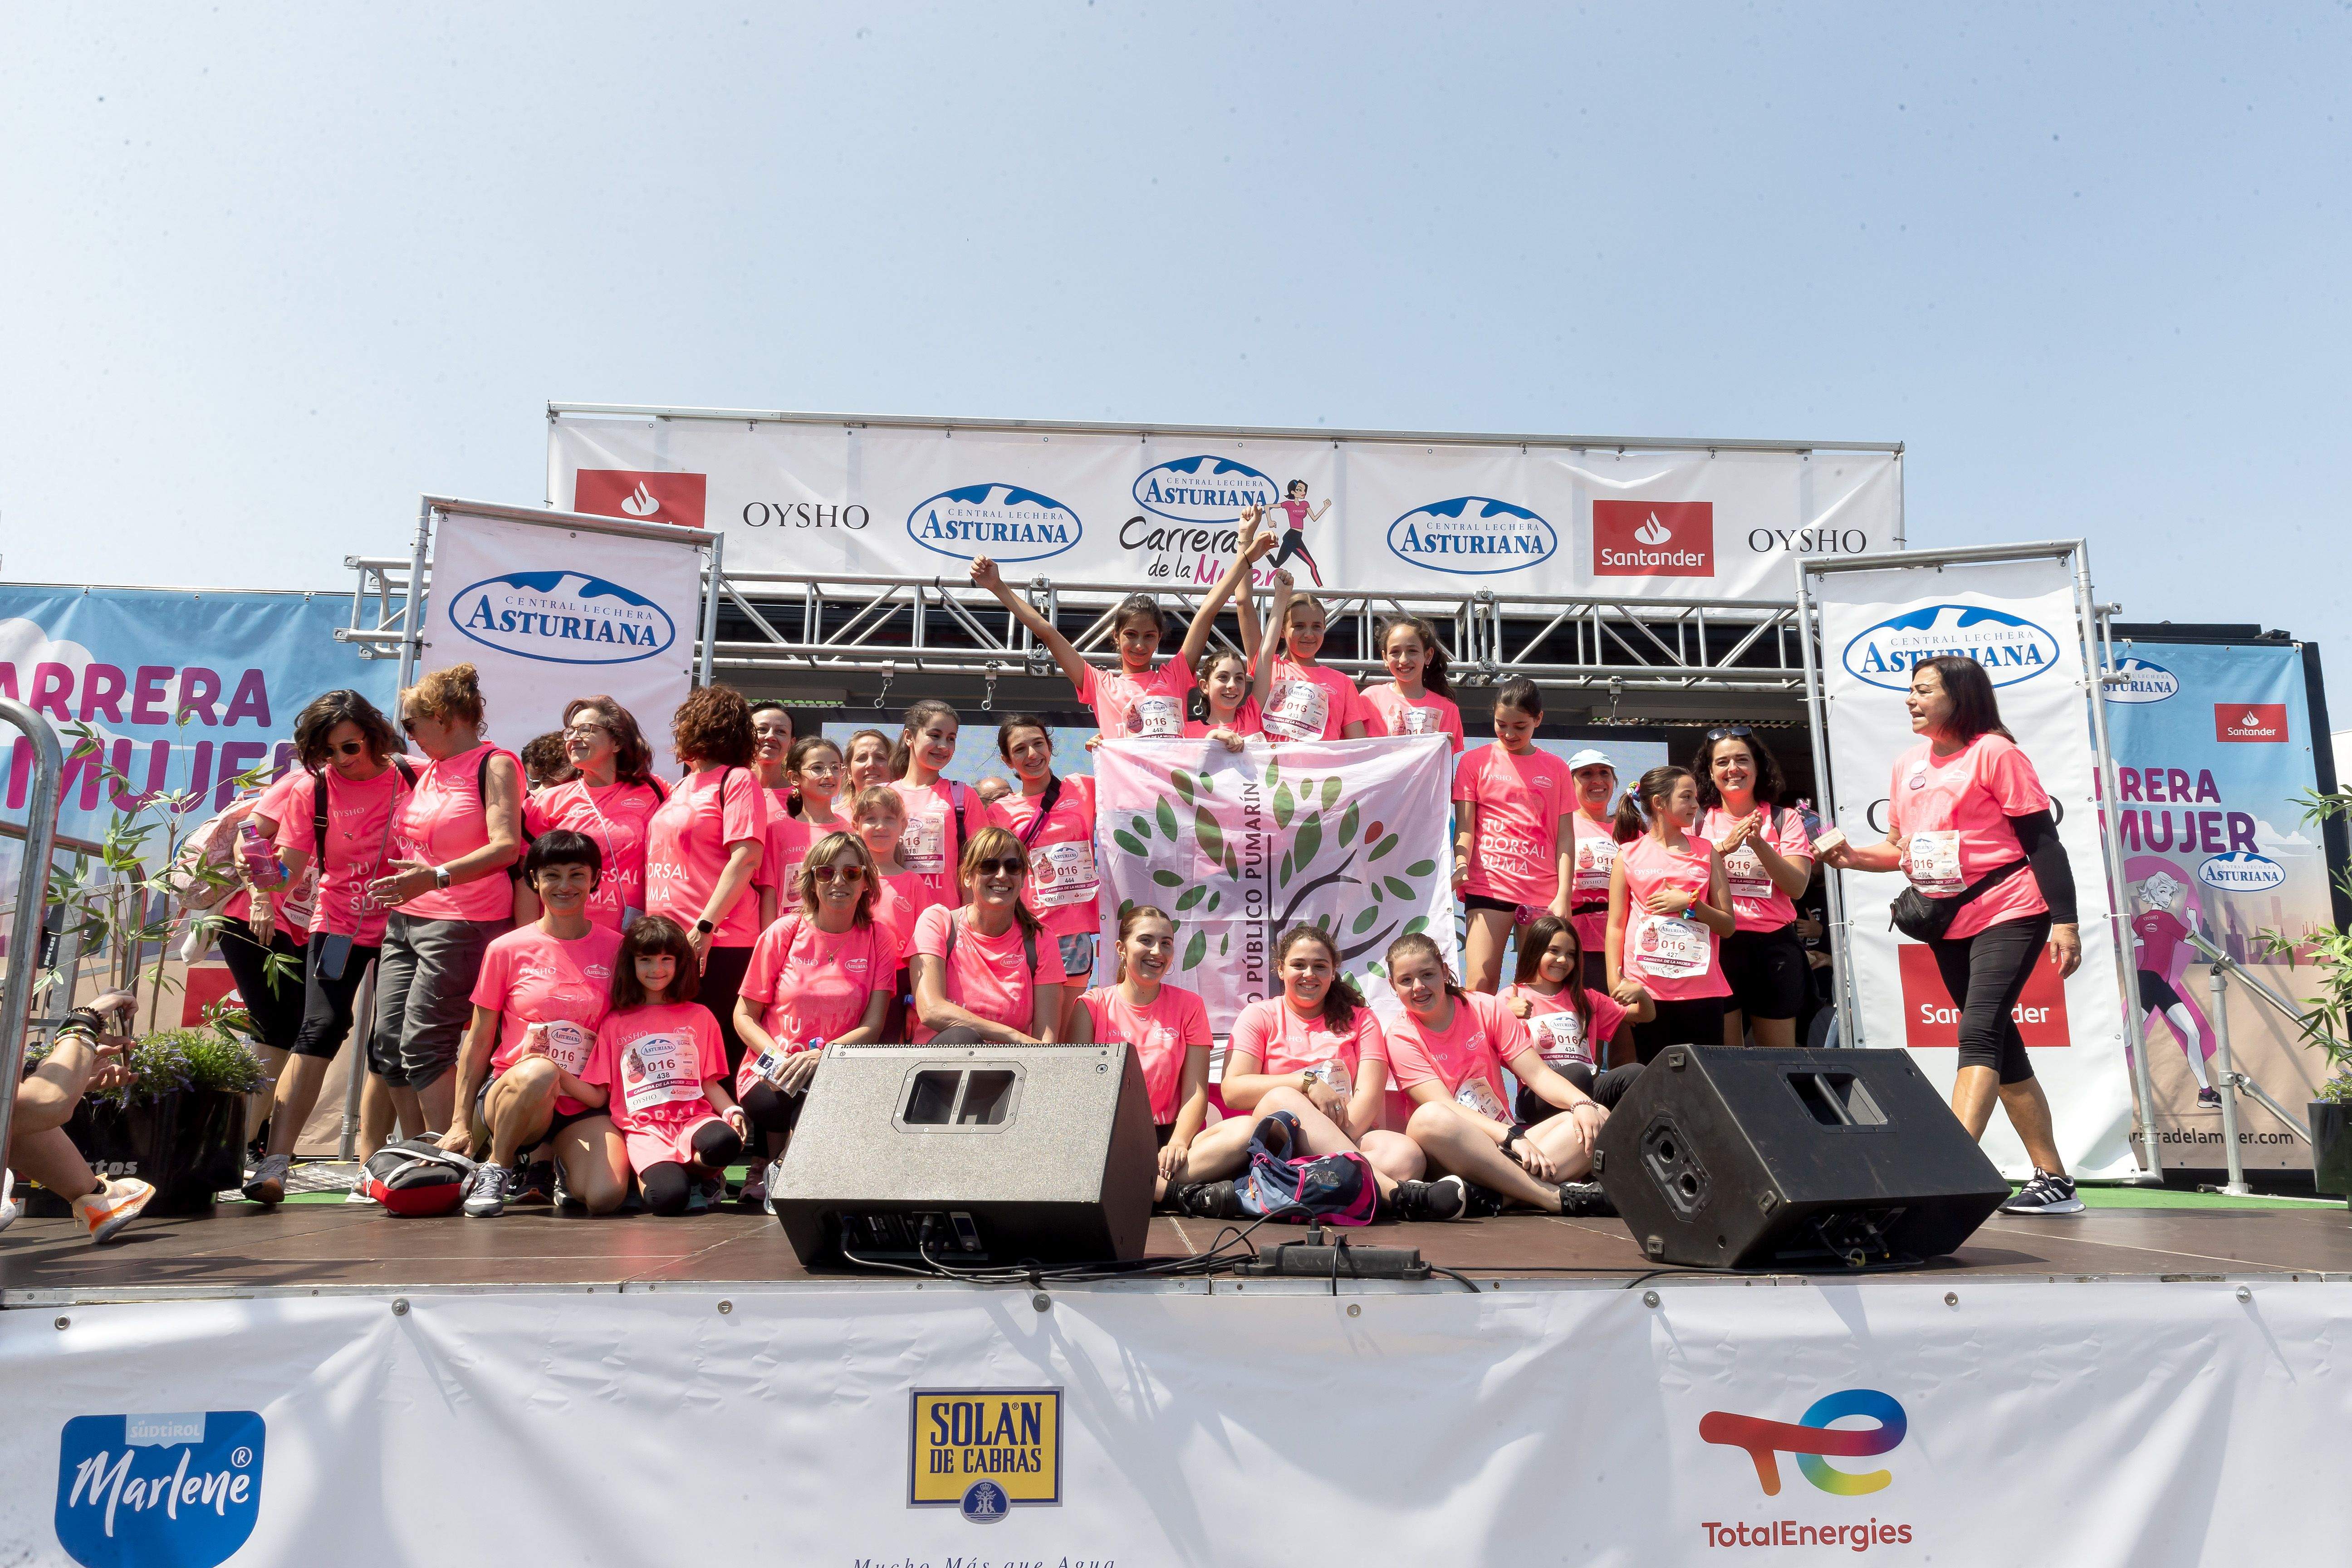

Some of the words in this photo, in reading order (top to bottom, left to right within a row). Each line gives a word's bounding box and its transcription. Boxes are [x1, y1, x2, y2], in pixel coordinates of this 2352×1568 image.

[1166, 477, 1213, 486] CENTRAL
[1216, 479, 1264, 487] LECHERA
[1143, 478, 1267, 507] ASTURIANA
[742, 502, 870, 529] OYSHO
[948, 507, 1003, 519] CENTRAL
[1008, 511, 1064, 521] LECHERA
[921, 509, 1069, 544] ASTURIANA
[1426, 521, 1480, 531] CENTRAL
[1485, 522, 1540, 531] LECHERA
[1119, 516, 1238, 554] Carrera
[1400, 523, 1546, 554] ASTURIANA
[1748, 528, 1867, 554] OYSHO
[1601, 547, 1706, 567] Santander
[1148, 553, 1170, 577] de
[1175, 554, 1191, 578] la
[505, 595, 576, 611] CENTRAL
[583, 604, 653, 621] LECHERA
[465, 594, 658, 647] ASTURIANA
[1891, 635, 1957, 646] CENTRAL
[1965, 631, 2034, 642] LECHERA
[1287, 702, 1308, 713] 016
[1145, 717, 1167, 726] 016
[1295, 720, 1308, 729] MUJER
[2228, 726, 2276, 738] Santander
[333, 807, 365, 818] OYSHO
[1239, 782, 1262, 879] PUMARÍN
[1482, 817, 1505, 833] TU
[1482, 836, 1547, 860] DORSAL
[348, 862, 370, 877] TU
[646, 862, 690, 880] ORSAL
[1057, 866, 1078, 876] 016
[1480, 853, 1529, 875] SUMA
[1634, 867, 1664, 876] OYSHO
[1727, 860, 1751, 870] 016
[1914, 859, 1934, 869] 016
[2205, 866, 2279, 882] ASTURIANA
[1241, 888, 1264, 983] PÚBLICO
[1661, 940, 1686, 951] 016
[782, 1014, 802, 1034] TU
[554, 1031, 580, 1043] ASTURIANA
[617, 1030, 648, 1046] OYSHO
[1557, 1034, 1579, 1045] 016
[551, 1048, 575, 1062] 016
[643, 1045, 674, 1054] ASTURIANA
[647, 1058, 676, 1072] 016
[656, 1072, 671, 1080] 438
[633, 1084, 655, 1094] CARRERA
[632, 1094, 657, 1106] OYSHO
[929, 1448, 954, 1474] DE
[963, 1447, 1042, 1474] CABRAS
[1701, 1518, 1913, 1553] TotalEnergies
